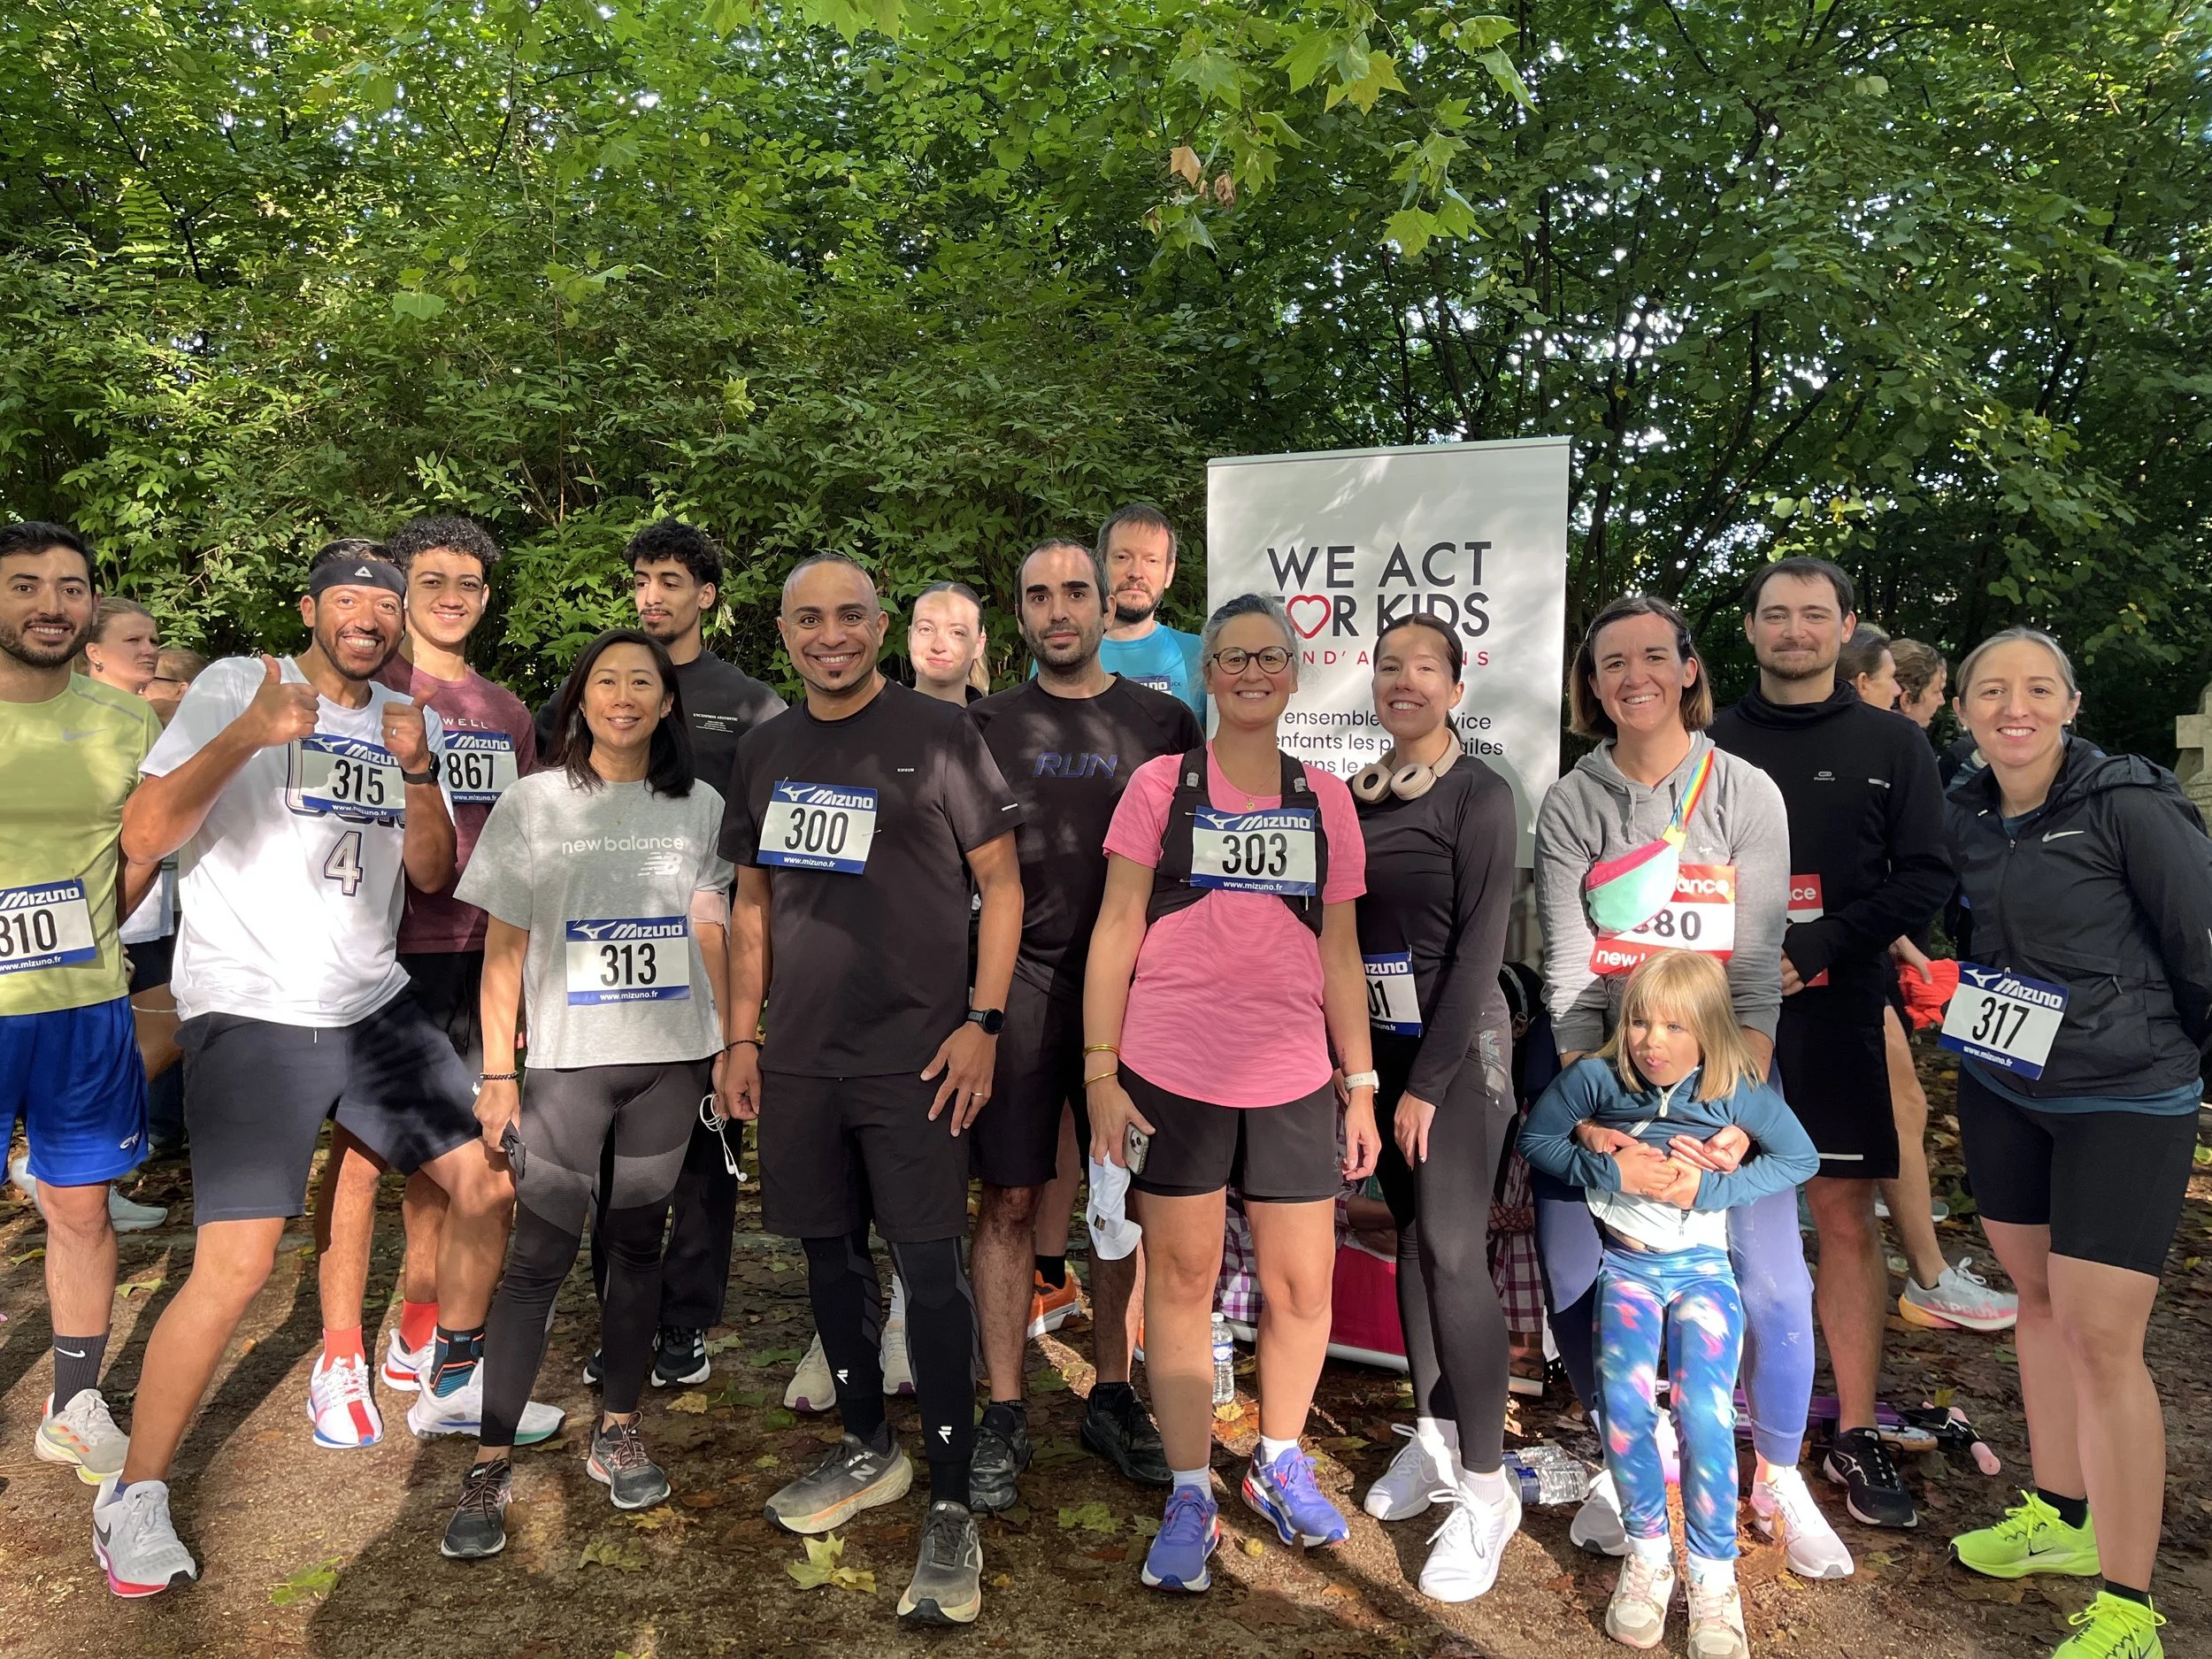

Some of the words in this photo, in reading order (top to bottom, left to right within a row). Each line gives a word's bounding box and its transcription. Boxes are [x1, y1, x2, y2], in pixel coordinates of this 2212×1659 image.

[1267, 546, 1355, 591] WE
[1378, 541, 1492, 588] ACT
[1284, 709, 1380, 726] ensemble
[1348, 733, 1375, 751] les
[447, 752, 494, 789] 867
[1033, 752, 1118, 779] RUN
[1342, 758, 1358, 773] le
[332, 759, 384, 806] 315
[332, 803, 388, 818] www.mizuno.fr
[784, 807, 849, 855] 300
[324, 830, 364, 897] 4
[783, 856, 836, 869] www.mizuno.fr
[1222, 833, 1287, 877] 303
[1223, 879, 1283, 891] www.mizuno.fr
[599, 942, 657, 987] 313
[1364, 961, 1409, 974] IZUNO
[1595, 949, 1637, 968] new
[599, 990, 658, 1002] www.mizuno.fr
[1366, 979, 1392, 1018] 01
[1971, 996, 2031, 1050] 317
[1963, 1045, 2014, 1068] www.mizuno.fr
